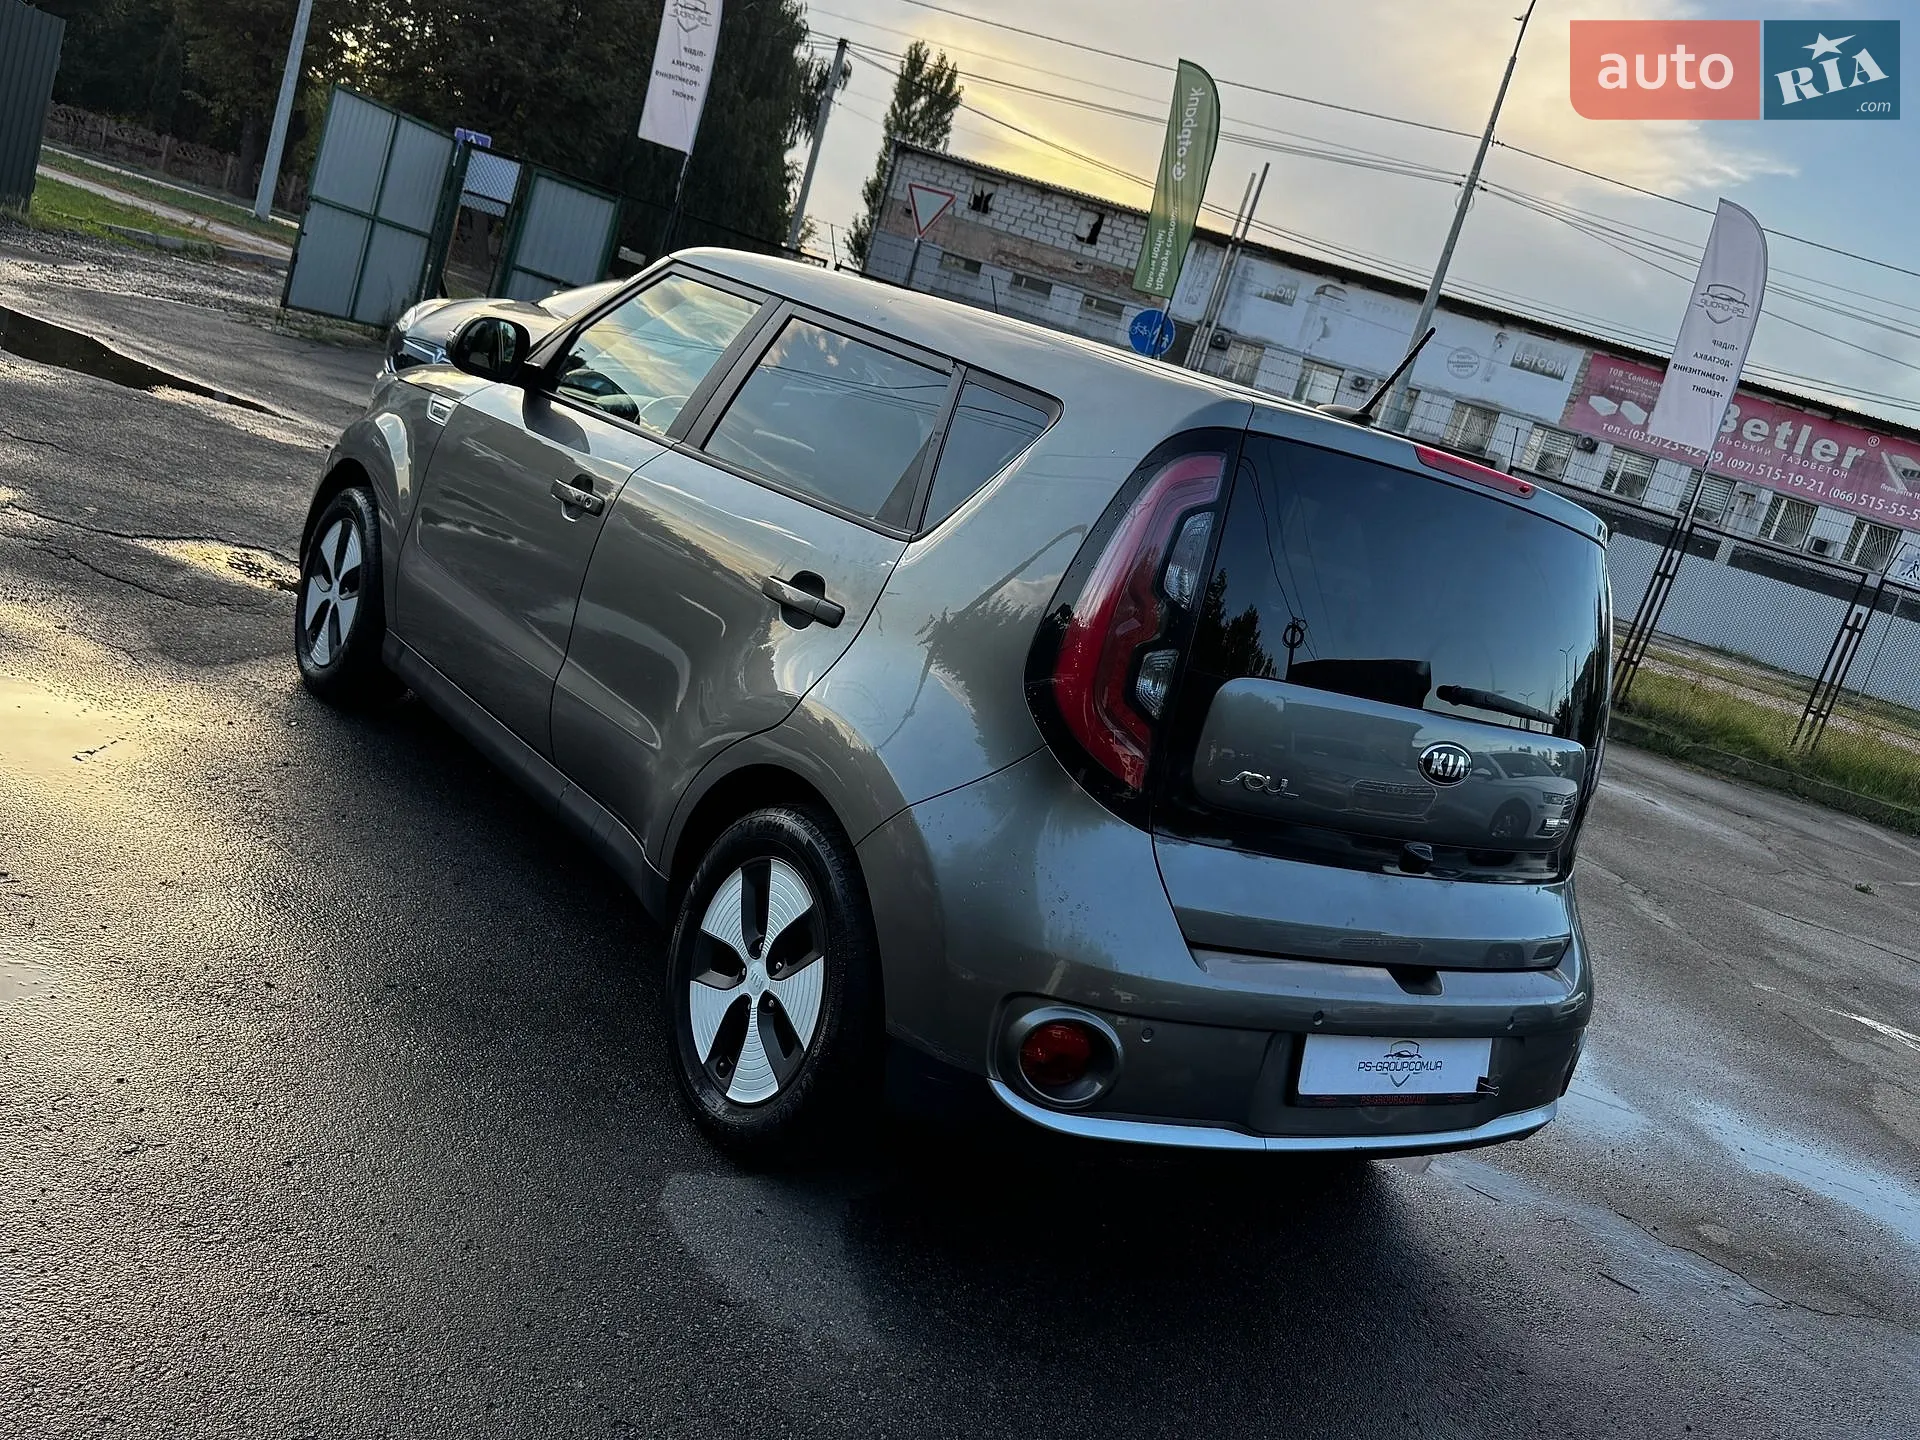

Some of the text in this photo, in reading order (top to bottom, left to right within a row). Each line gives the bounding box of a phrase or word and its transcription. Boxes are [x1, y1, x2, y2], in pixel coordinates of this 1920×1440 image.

[1727, 456, 1755, 474] (097)
[1756, 464, 1826, 496] 515-19-21,
[1828, 487, 1857, 505] (066)
[1781, 453, 1848, 480] ГАЗОБЕТОН
[1430, 751, 1466, 779] KIA
